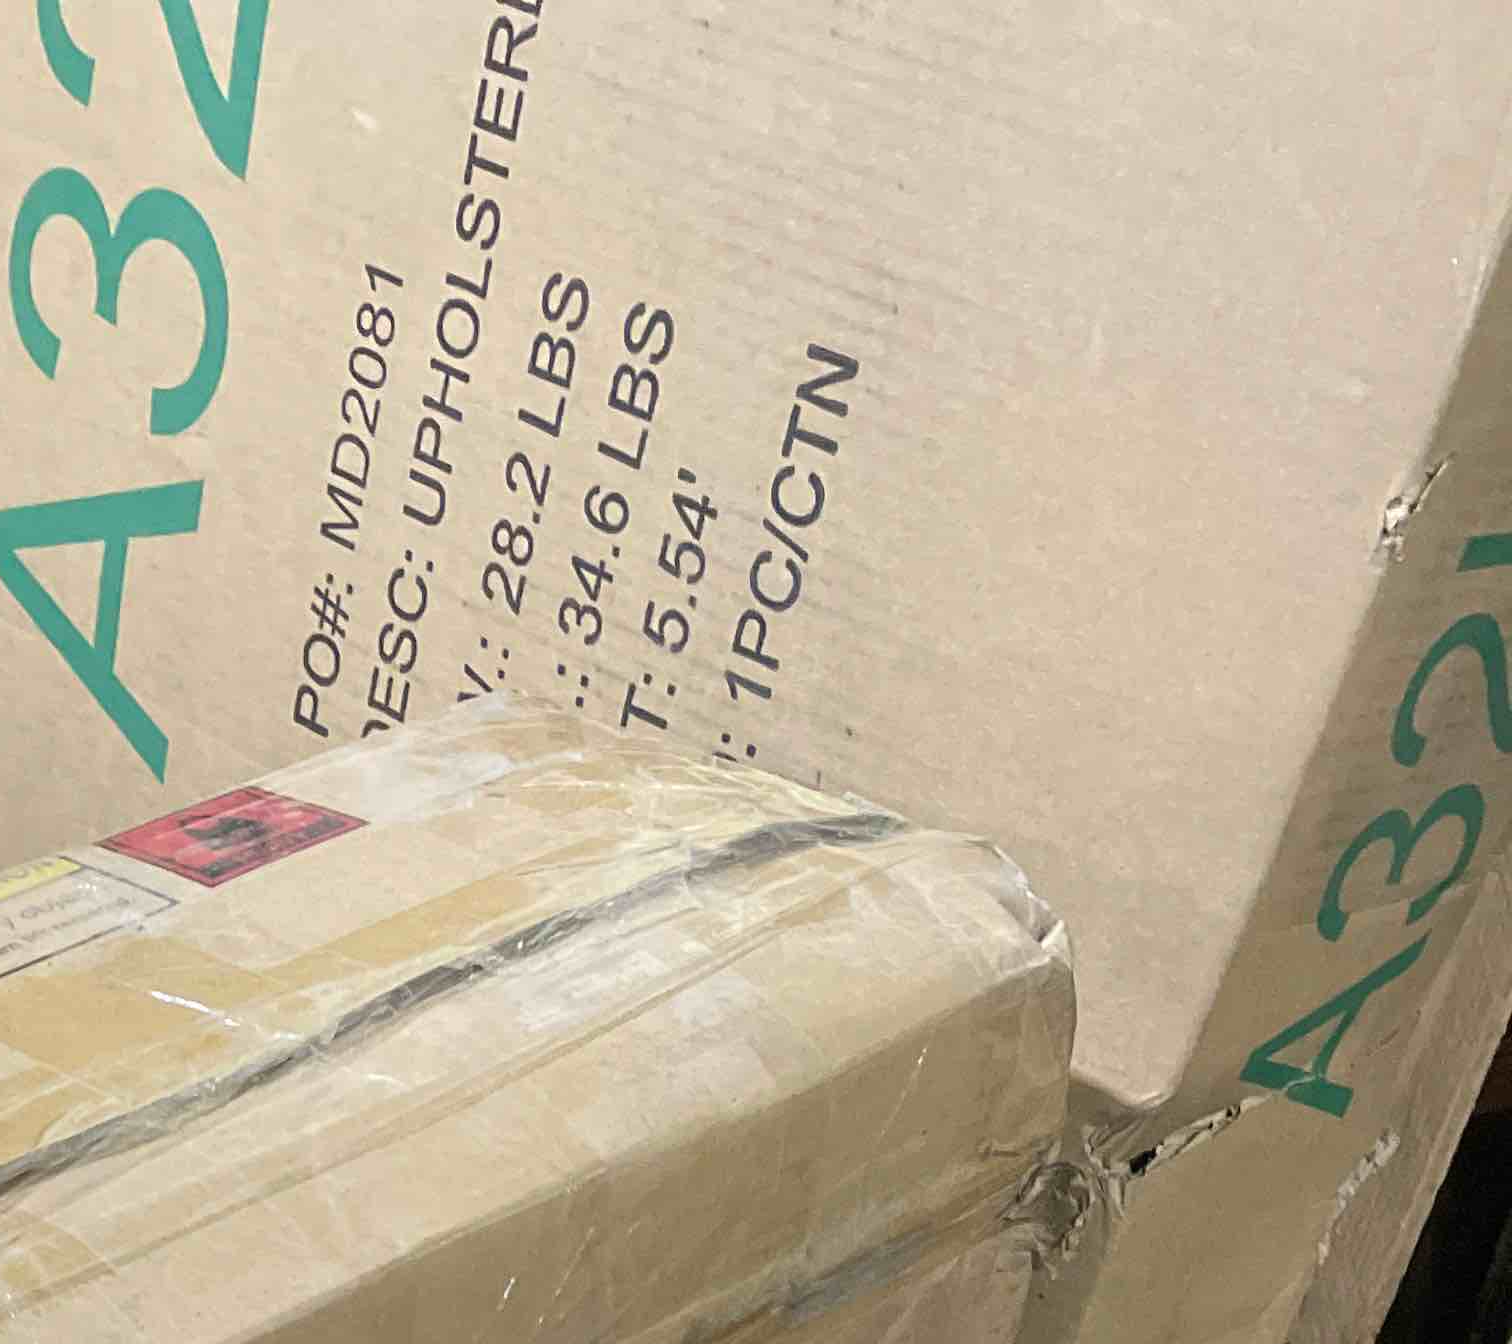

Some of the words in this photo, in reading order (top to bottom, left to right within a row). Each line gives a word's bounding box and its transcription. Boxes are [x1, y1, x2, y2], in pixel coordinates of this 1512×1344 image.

[321, 262, 405, 549] MD2081
[480, 451, 551, 613] 28.2
[519, 273, 590, 440] LBS
[556, 483, 633, 647] 34.6
[597, 301, 676, 471] LBS
[641, 469, 719, 655] 5.54'
[724, 342, 861, 700] 1PC/CTN
[293, 571, 358, 737] PO#:
